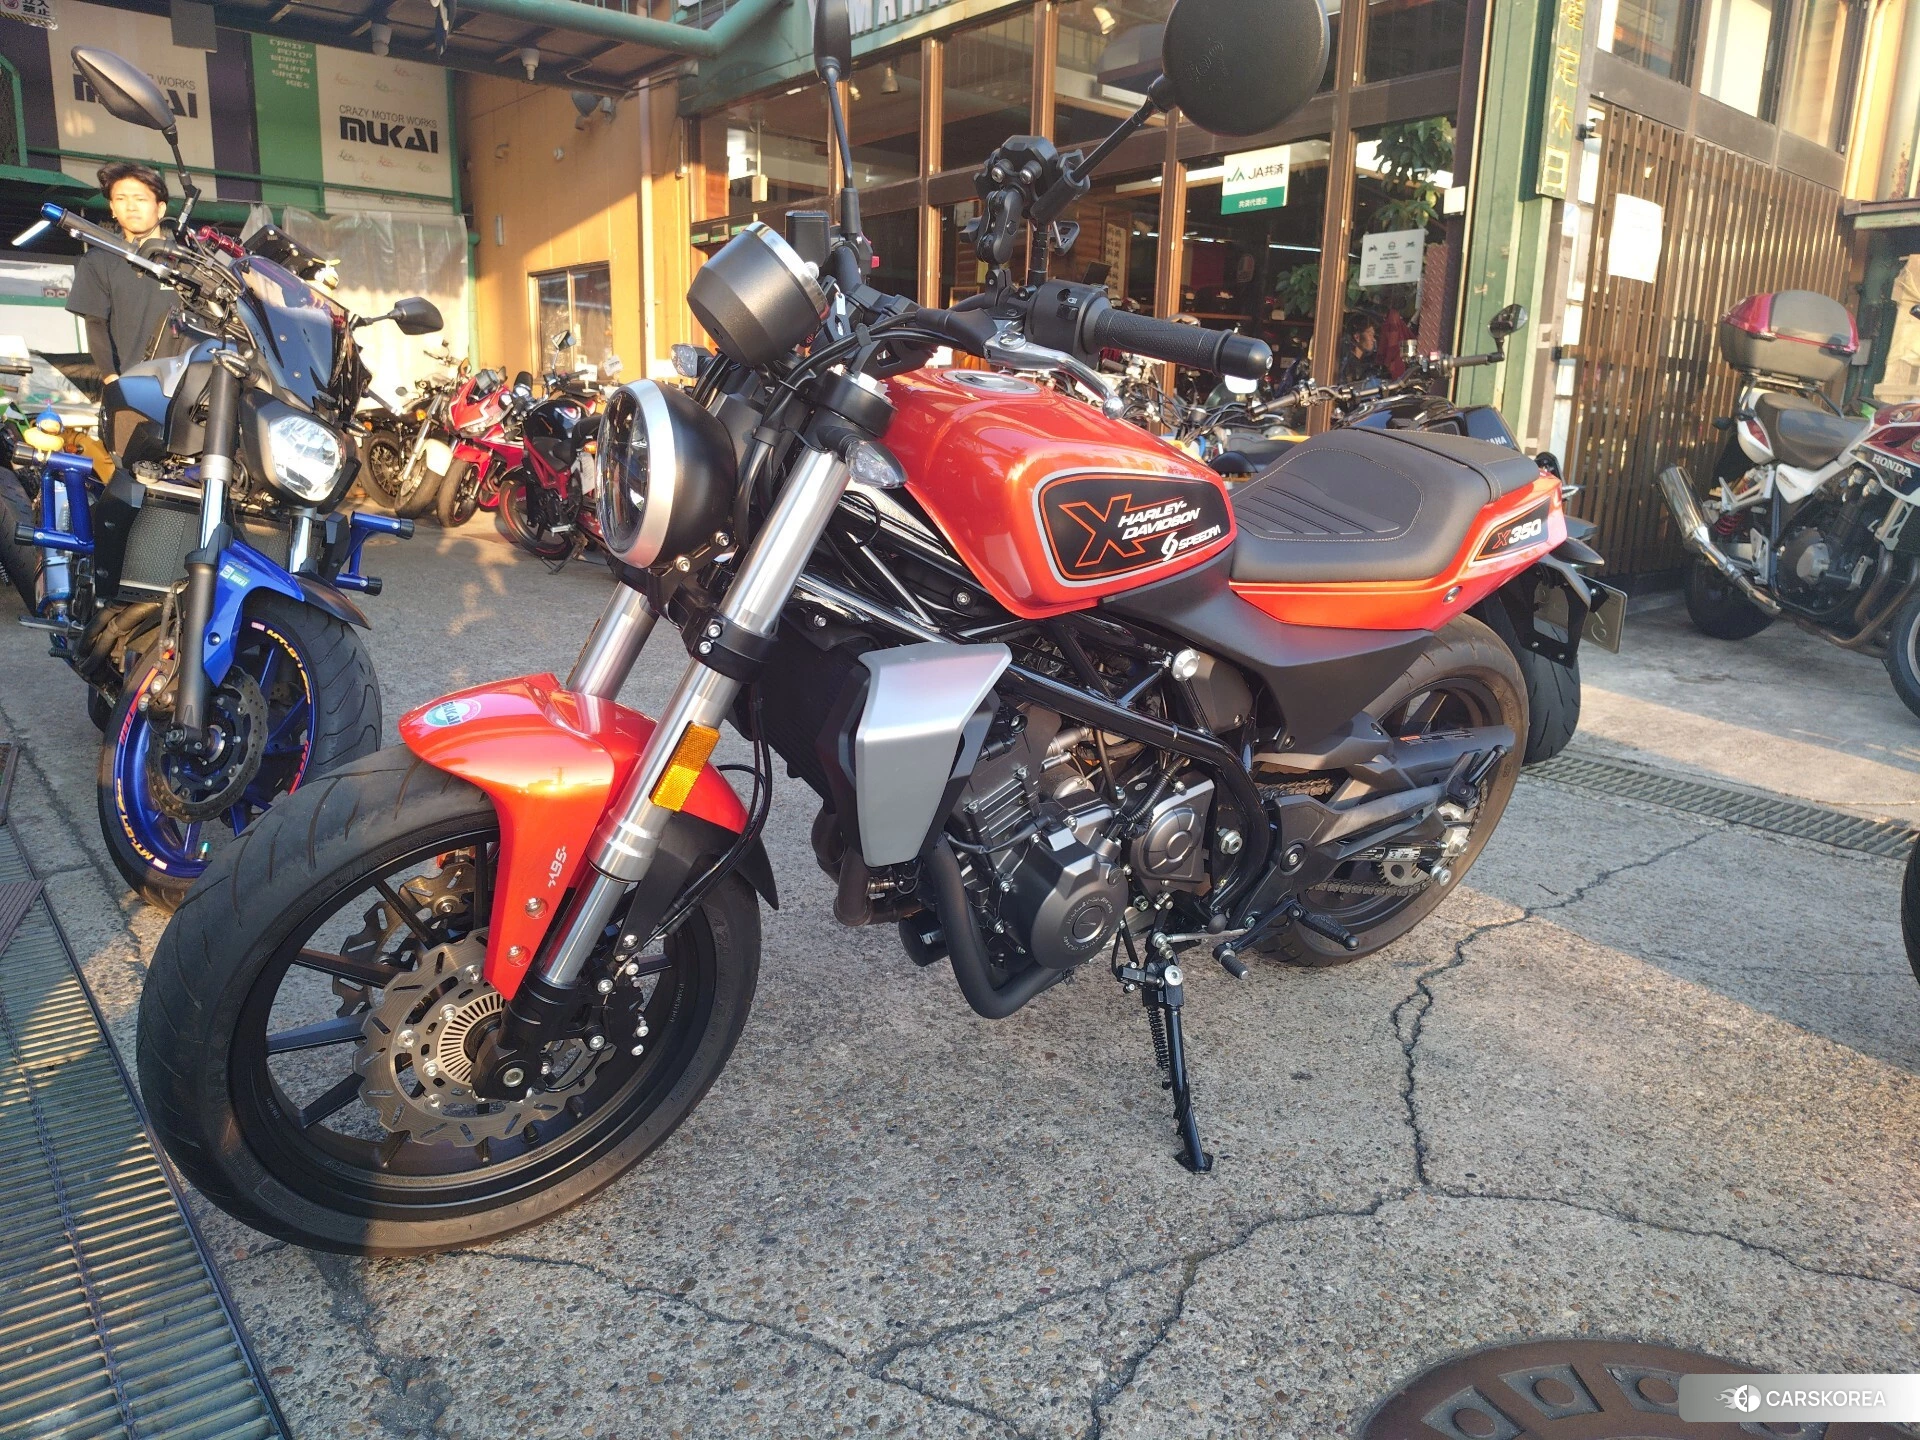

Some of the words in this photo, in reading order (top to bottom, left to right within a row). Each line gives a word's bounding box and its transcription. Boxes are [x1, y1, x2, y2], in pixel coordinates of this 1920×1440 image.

[158, 76, 196, 90] WORKS
[339, 104, 370, 118] CRAZY
[371, 110, 404, 122] MOTOR
[406, 116, 438, 129] WORKS
[339, 115, 439, 154] MUKAI
[1872, 453, 1913, 478] HONDA
[1117, 500, 1187, 528] HARLEY-
[1121, 507, 1201, 541] DAVIDSON
[1492, 518, 1542, 549] X350
